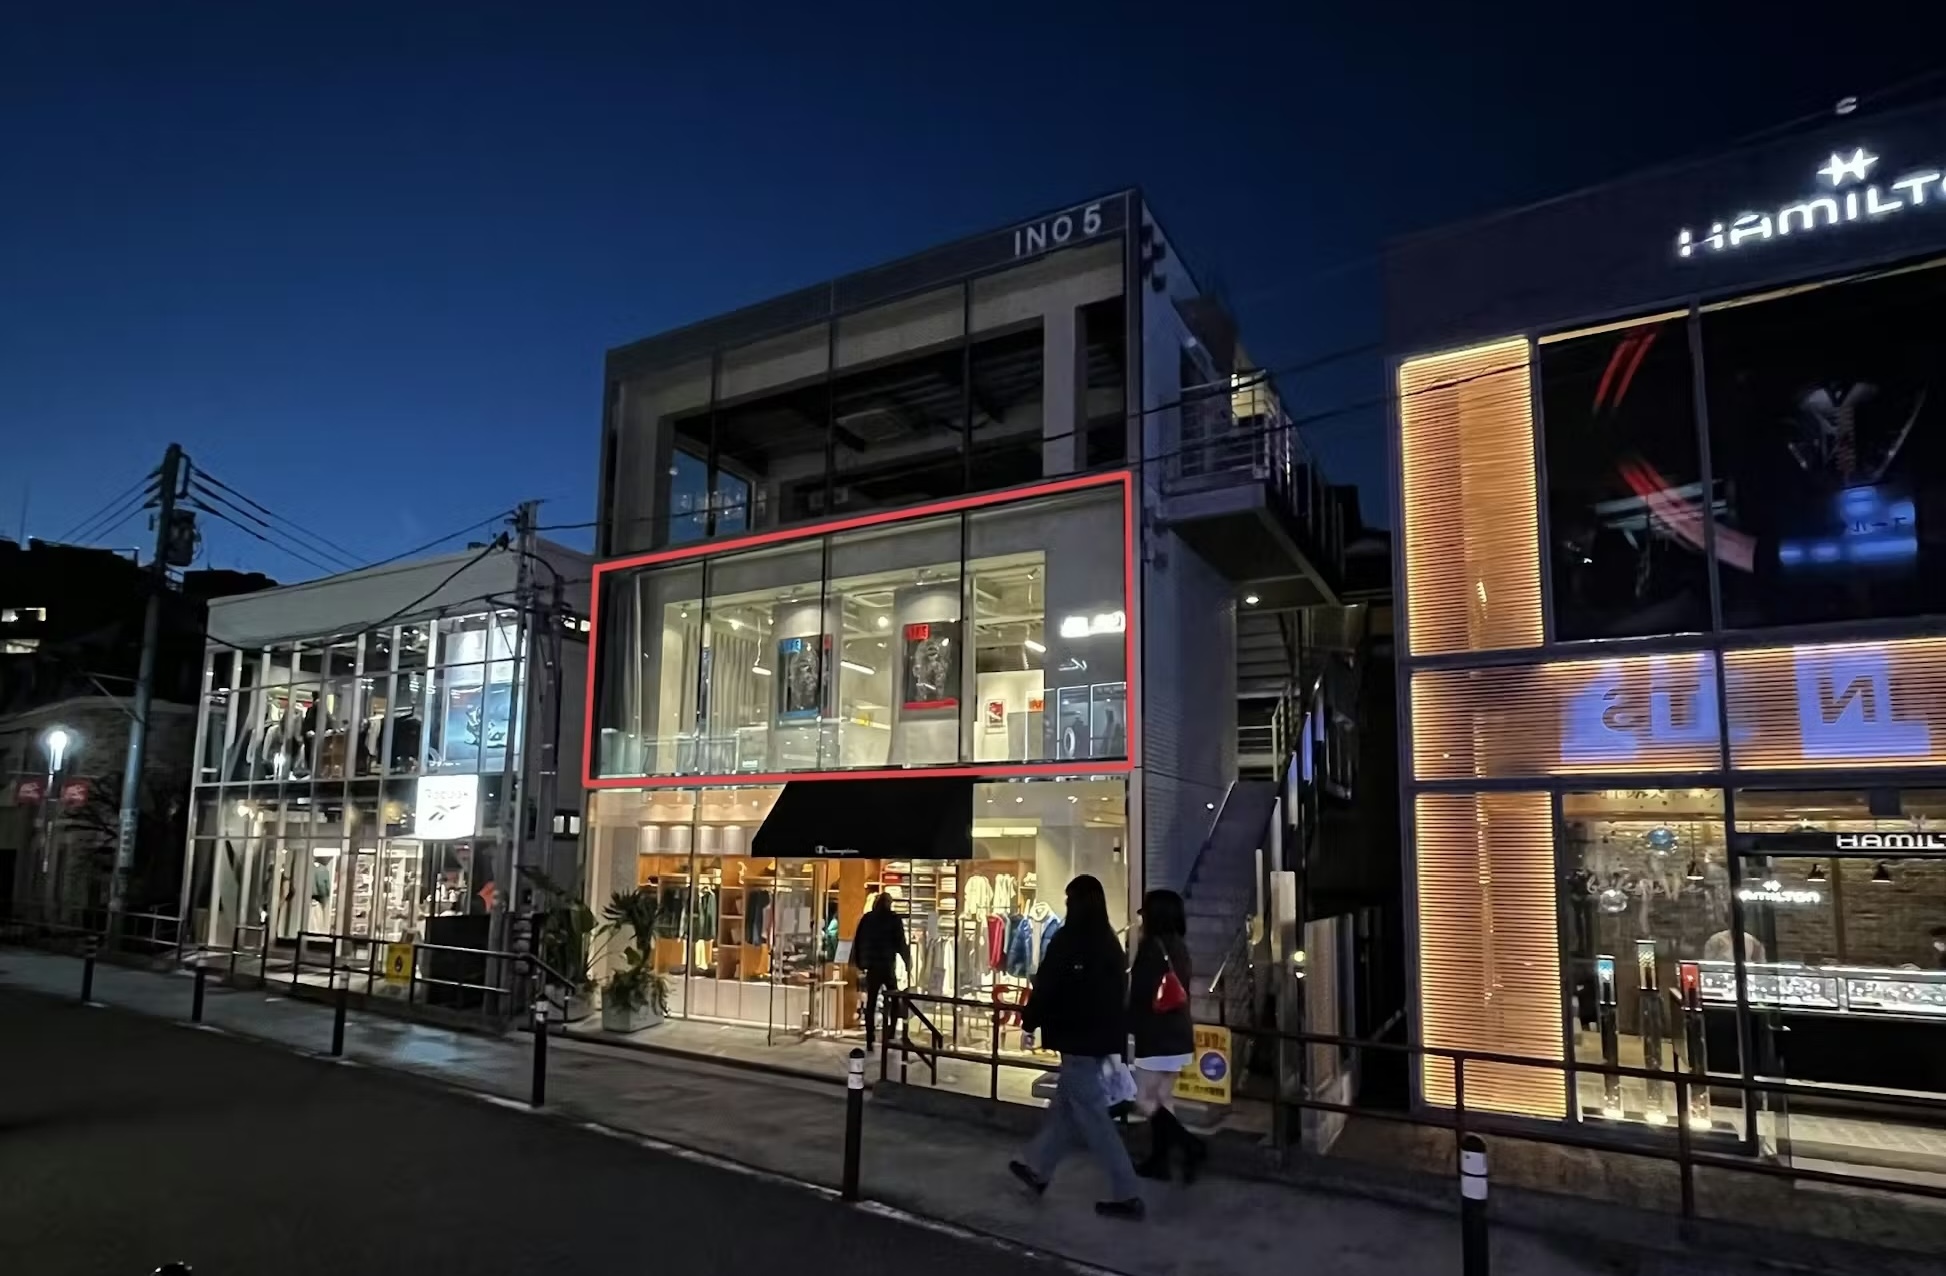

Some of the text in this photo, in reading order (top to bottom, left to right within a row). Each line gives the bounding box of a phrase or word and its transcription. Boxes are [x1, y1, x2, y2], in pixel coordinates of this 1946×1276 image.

[1014, 203, 1102, 257] INO 5
[1678, 172, 1946, 257] HAMILT
